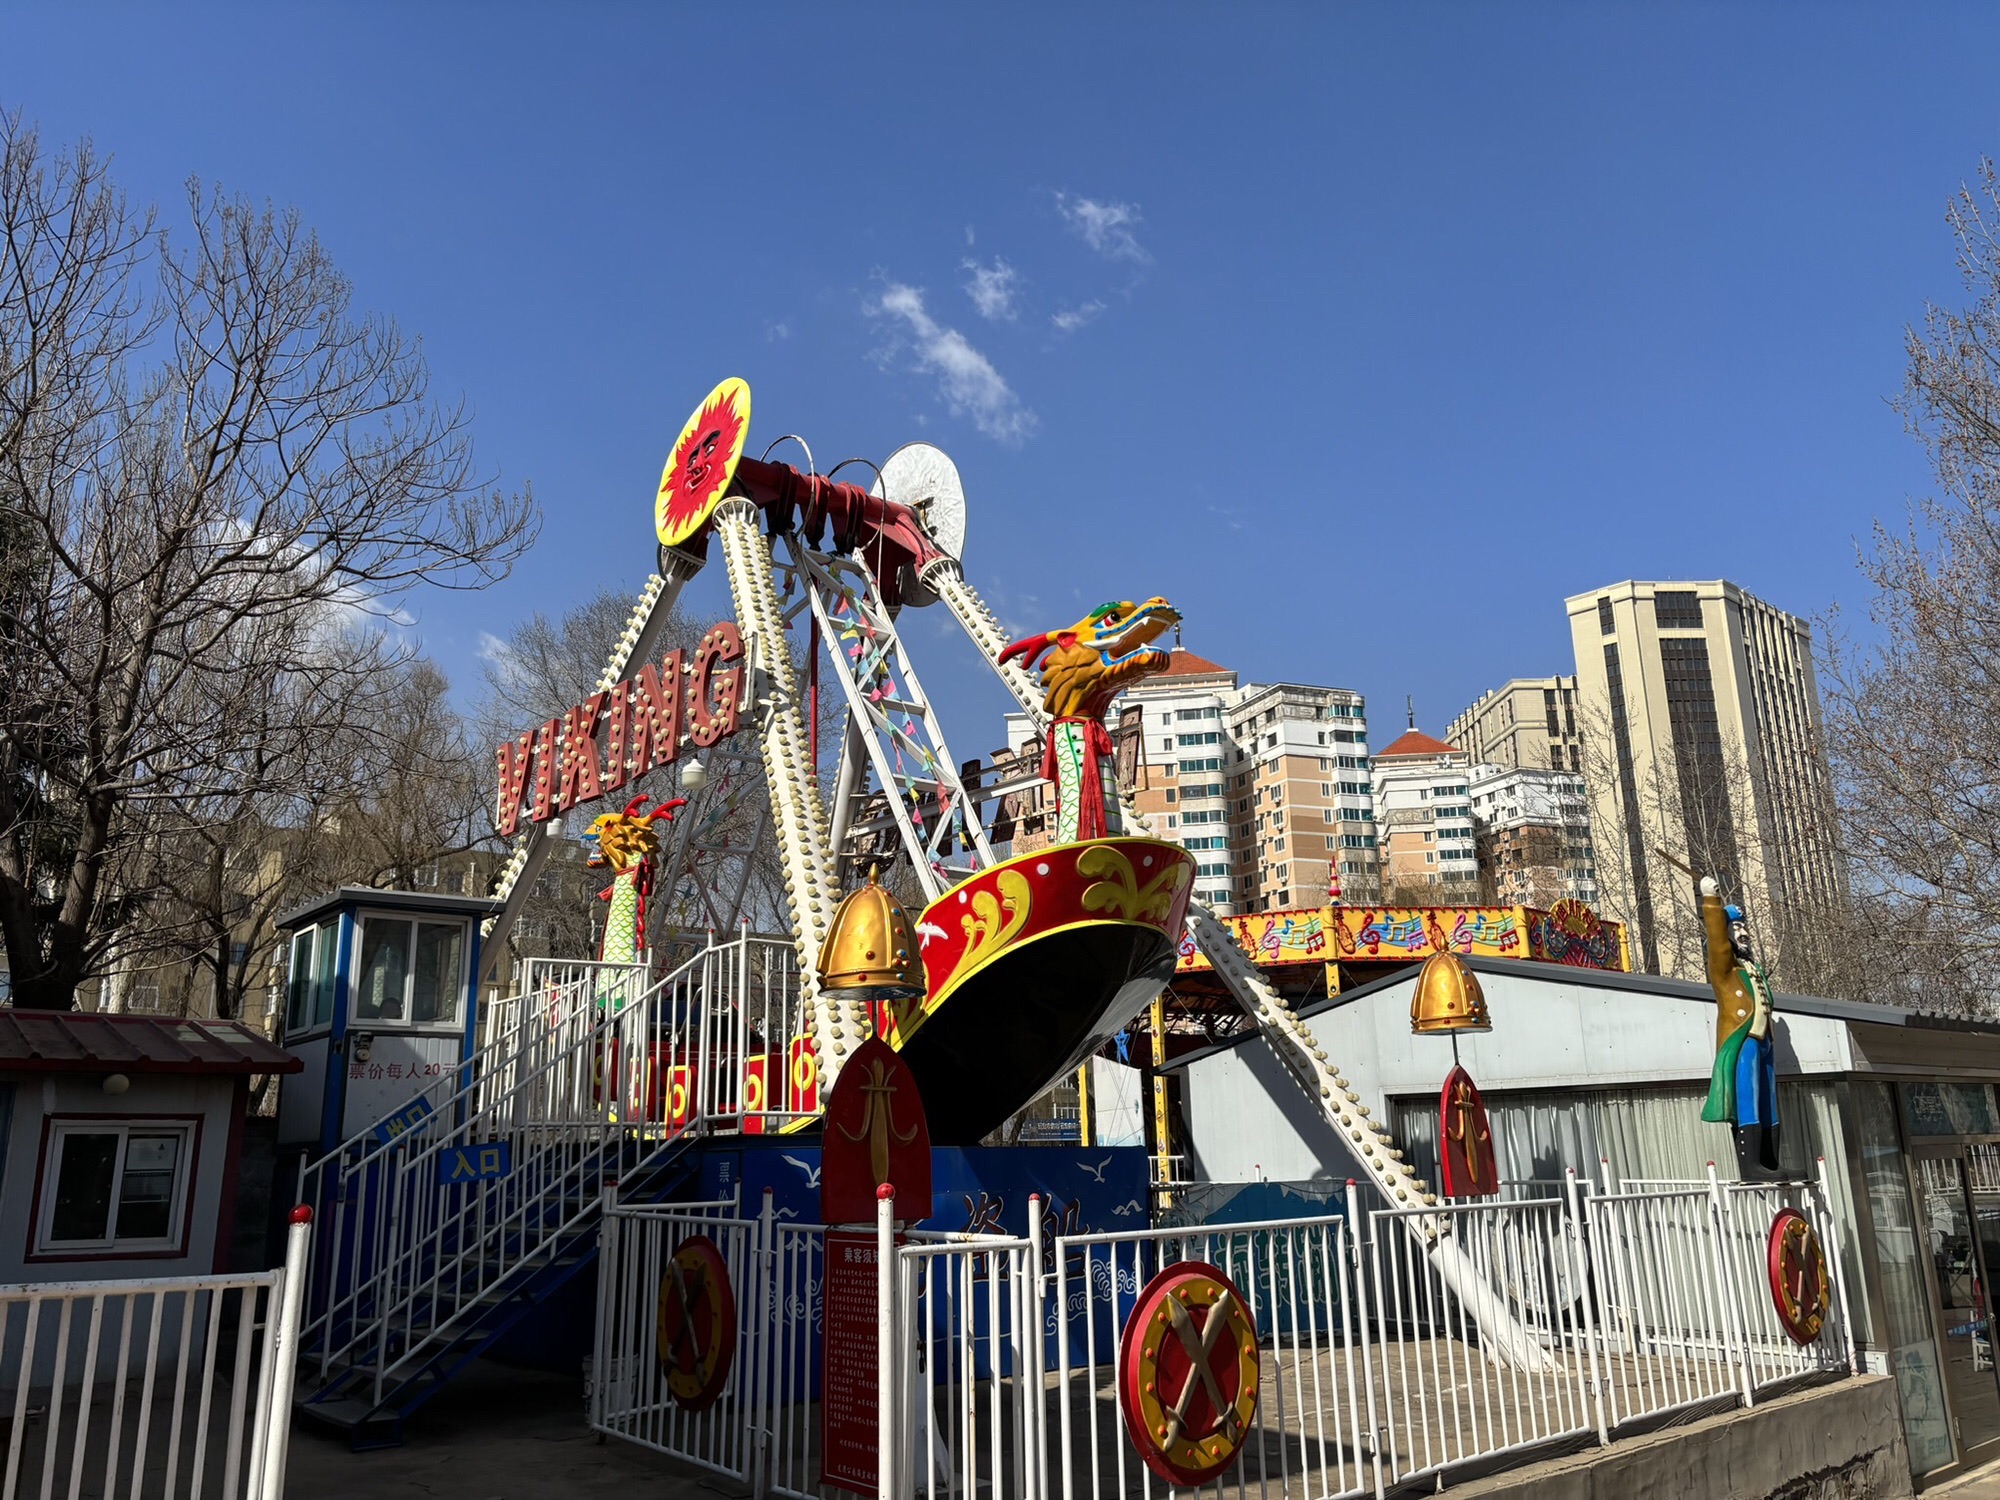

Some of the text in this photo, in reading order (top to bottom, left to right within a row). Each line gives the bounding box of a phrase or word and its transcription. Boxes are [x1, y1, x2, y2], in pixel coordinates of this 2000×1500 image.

[497, 622, 745, 836] VIKING
[386, 1105, 426, 1139] 出口
[451, 1148, 500, 1179] 入口
